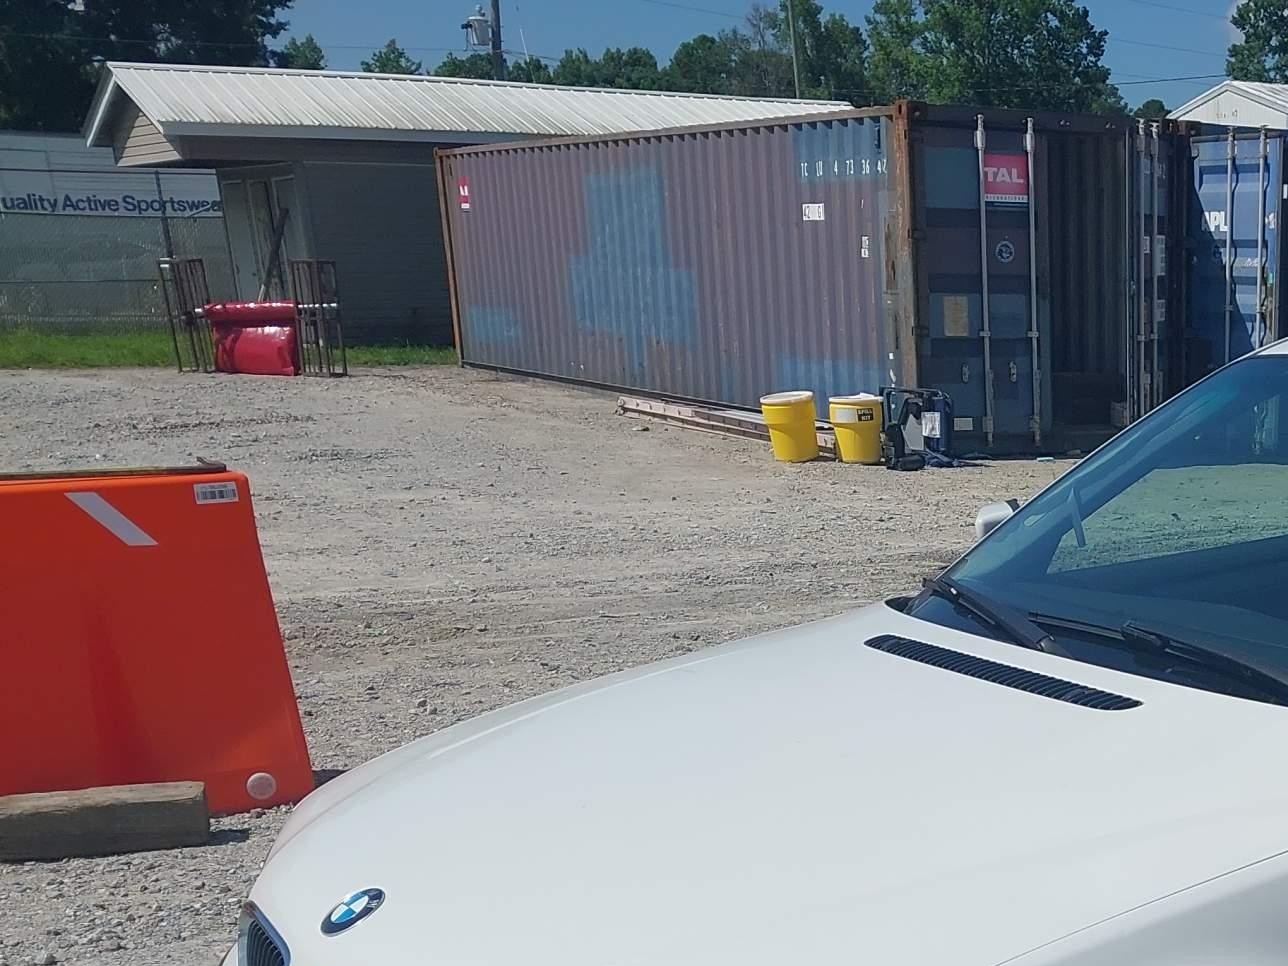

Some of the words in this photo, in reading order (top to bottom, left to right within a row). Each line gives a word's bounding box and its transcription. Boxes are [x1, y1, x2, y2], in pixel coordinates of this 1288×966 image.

[984, 166, 1024, 183] TAL
[62, 194, 120, 213] Active
[121, 194, 223, 215] Sportswea
[1201, 211, 1230, 233] APL
